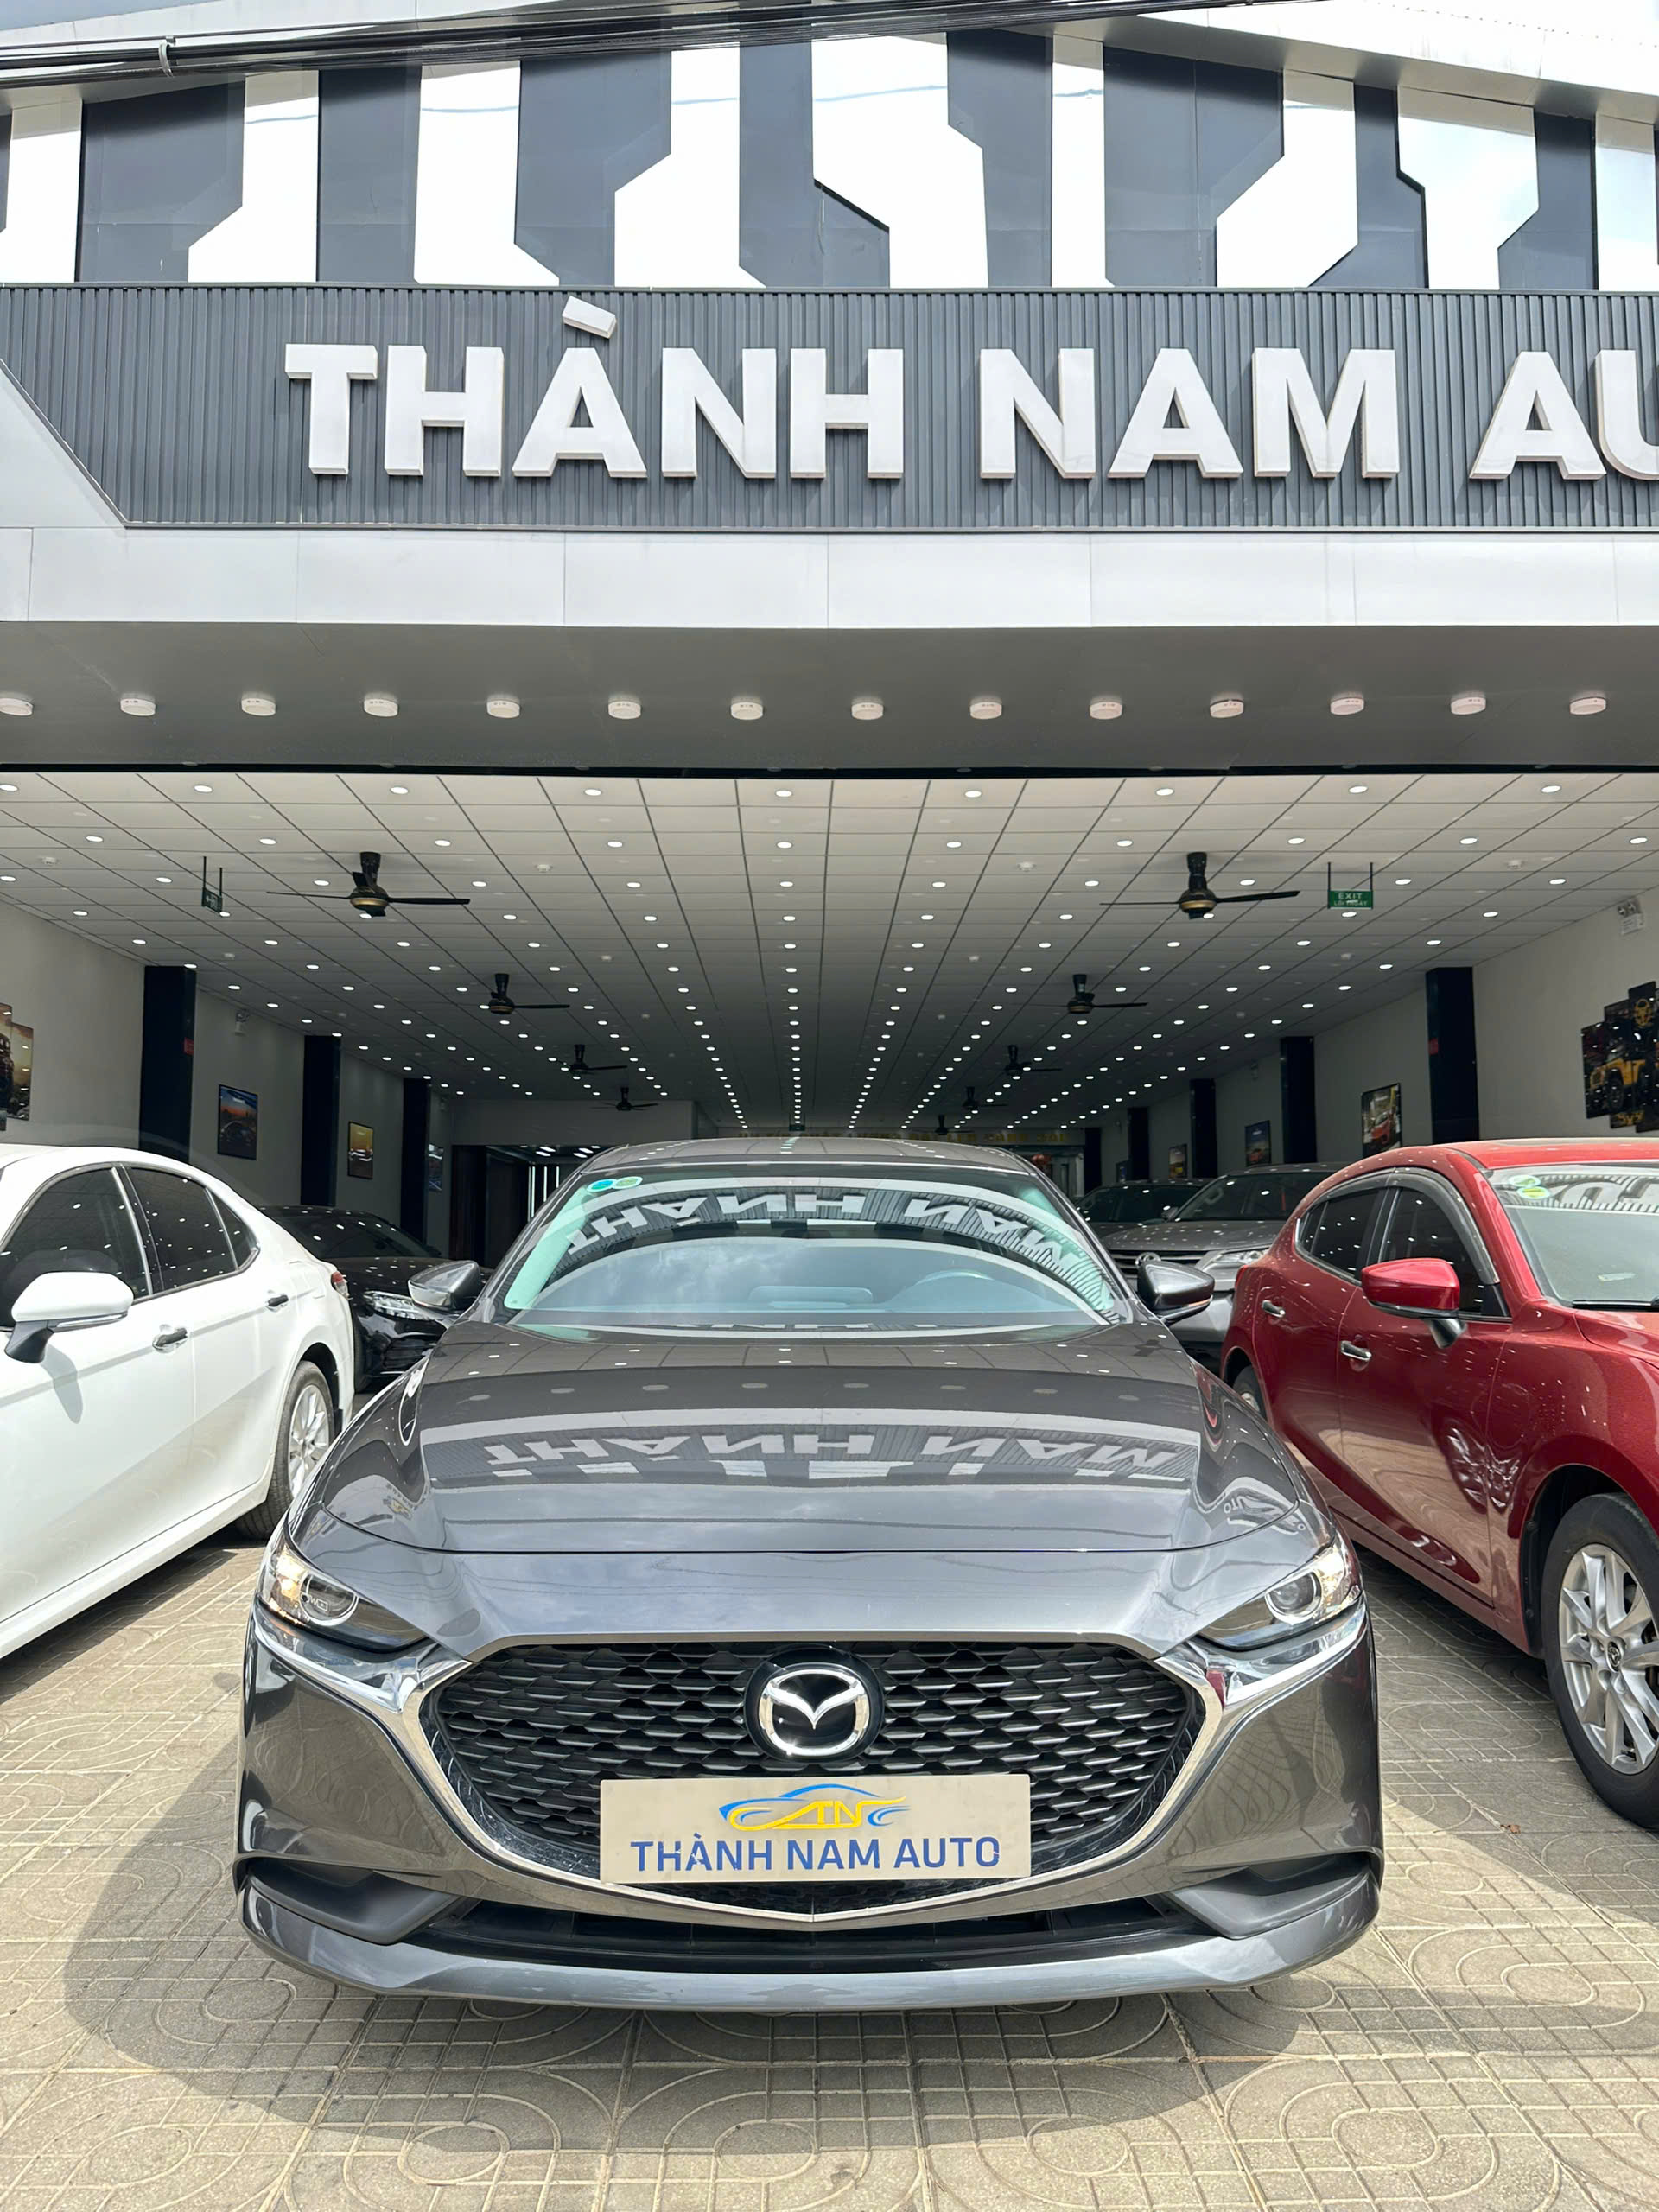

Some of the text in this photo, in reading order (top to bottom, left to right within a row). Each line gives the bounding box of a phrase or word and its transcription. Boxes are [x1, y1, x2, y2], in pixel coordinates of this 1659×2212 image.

[285, 296, 904, 479] THÀNH
[978, 347, 1400, 480] NAM
[630, 1832, 1000, 1872] THÀNH NAM AUTO
